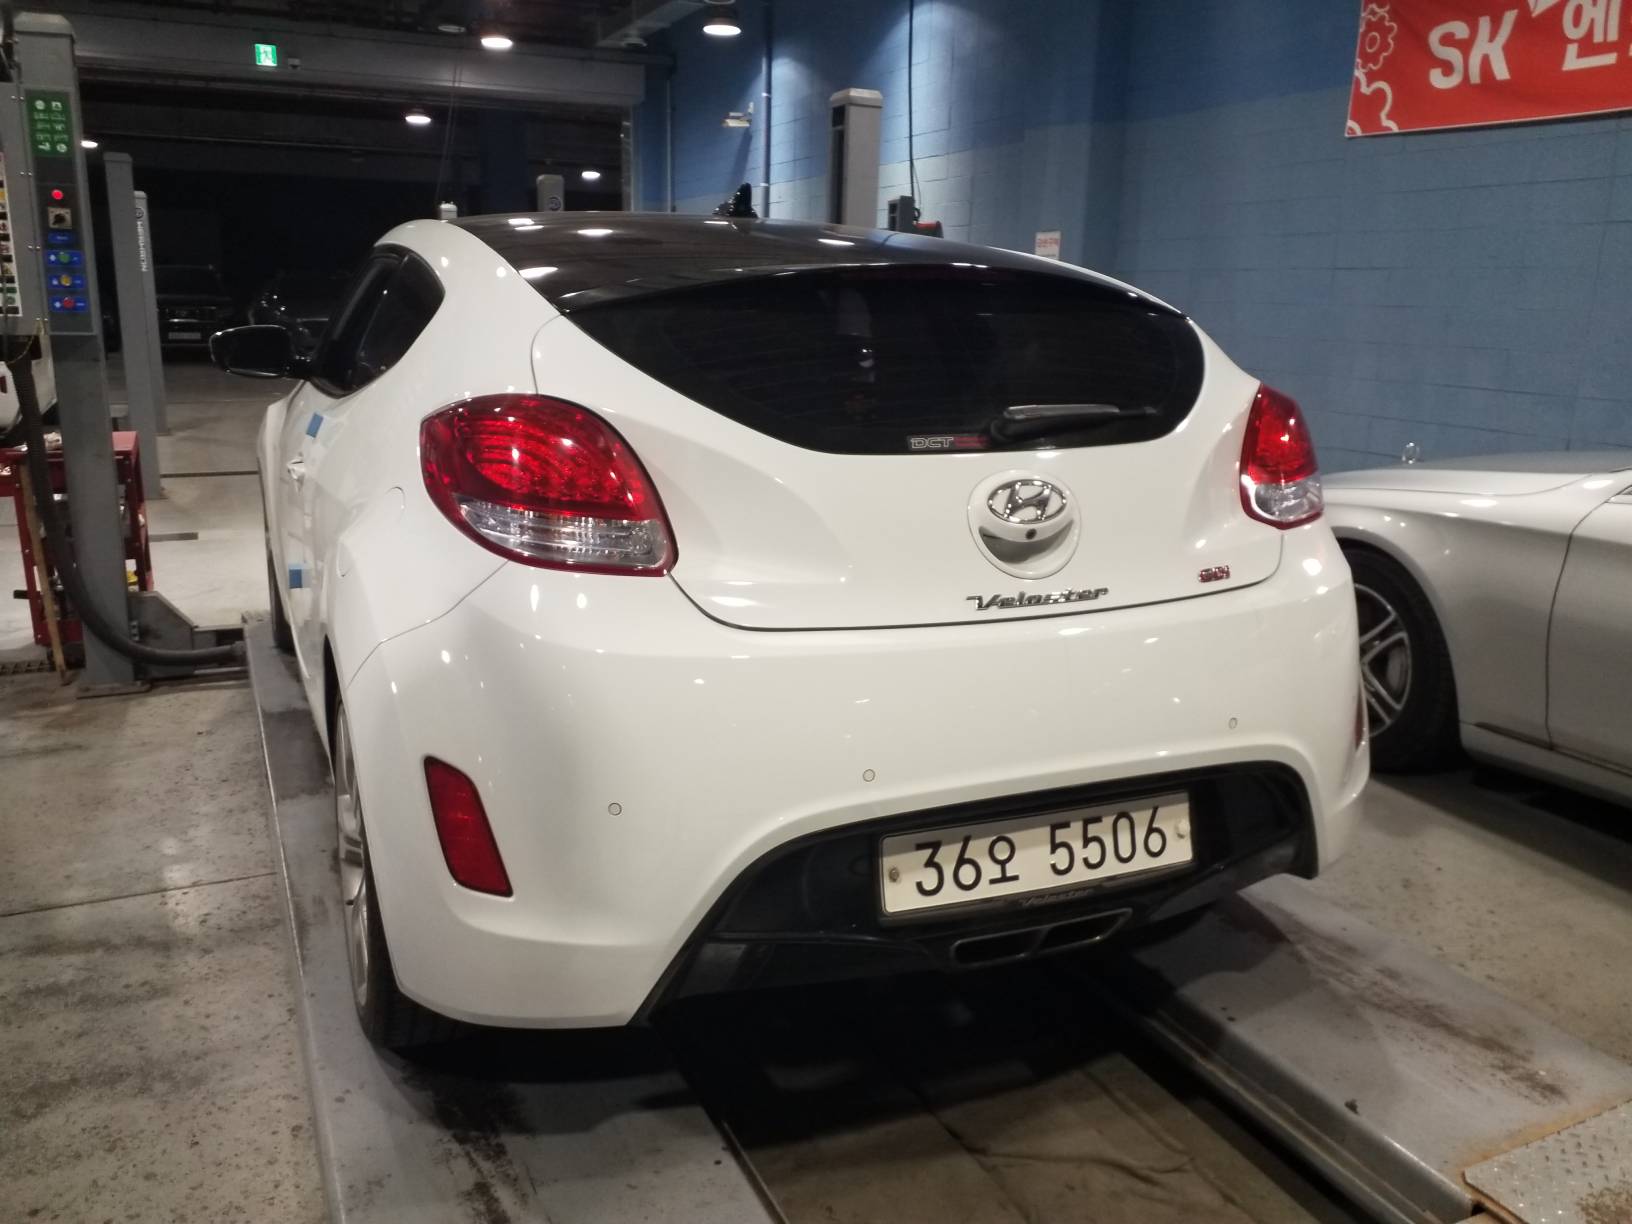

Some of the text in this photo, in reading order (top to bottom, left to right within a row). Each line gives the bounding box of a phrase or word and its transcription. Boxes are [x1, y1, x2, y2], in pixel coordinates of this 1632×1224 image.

[1428, 0, 1632, 90] SK 엔
[910, 436, 955, 449] DCT
[966, 587, 1109, 610] Veloster
[914, 806, 1167, 897] 36오 5506
